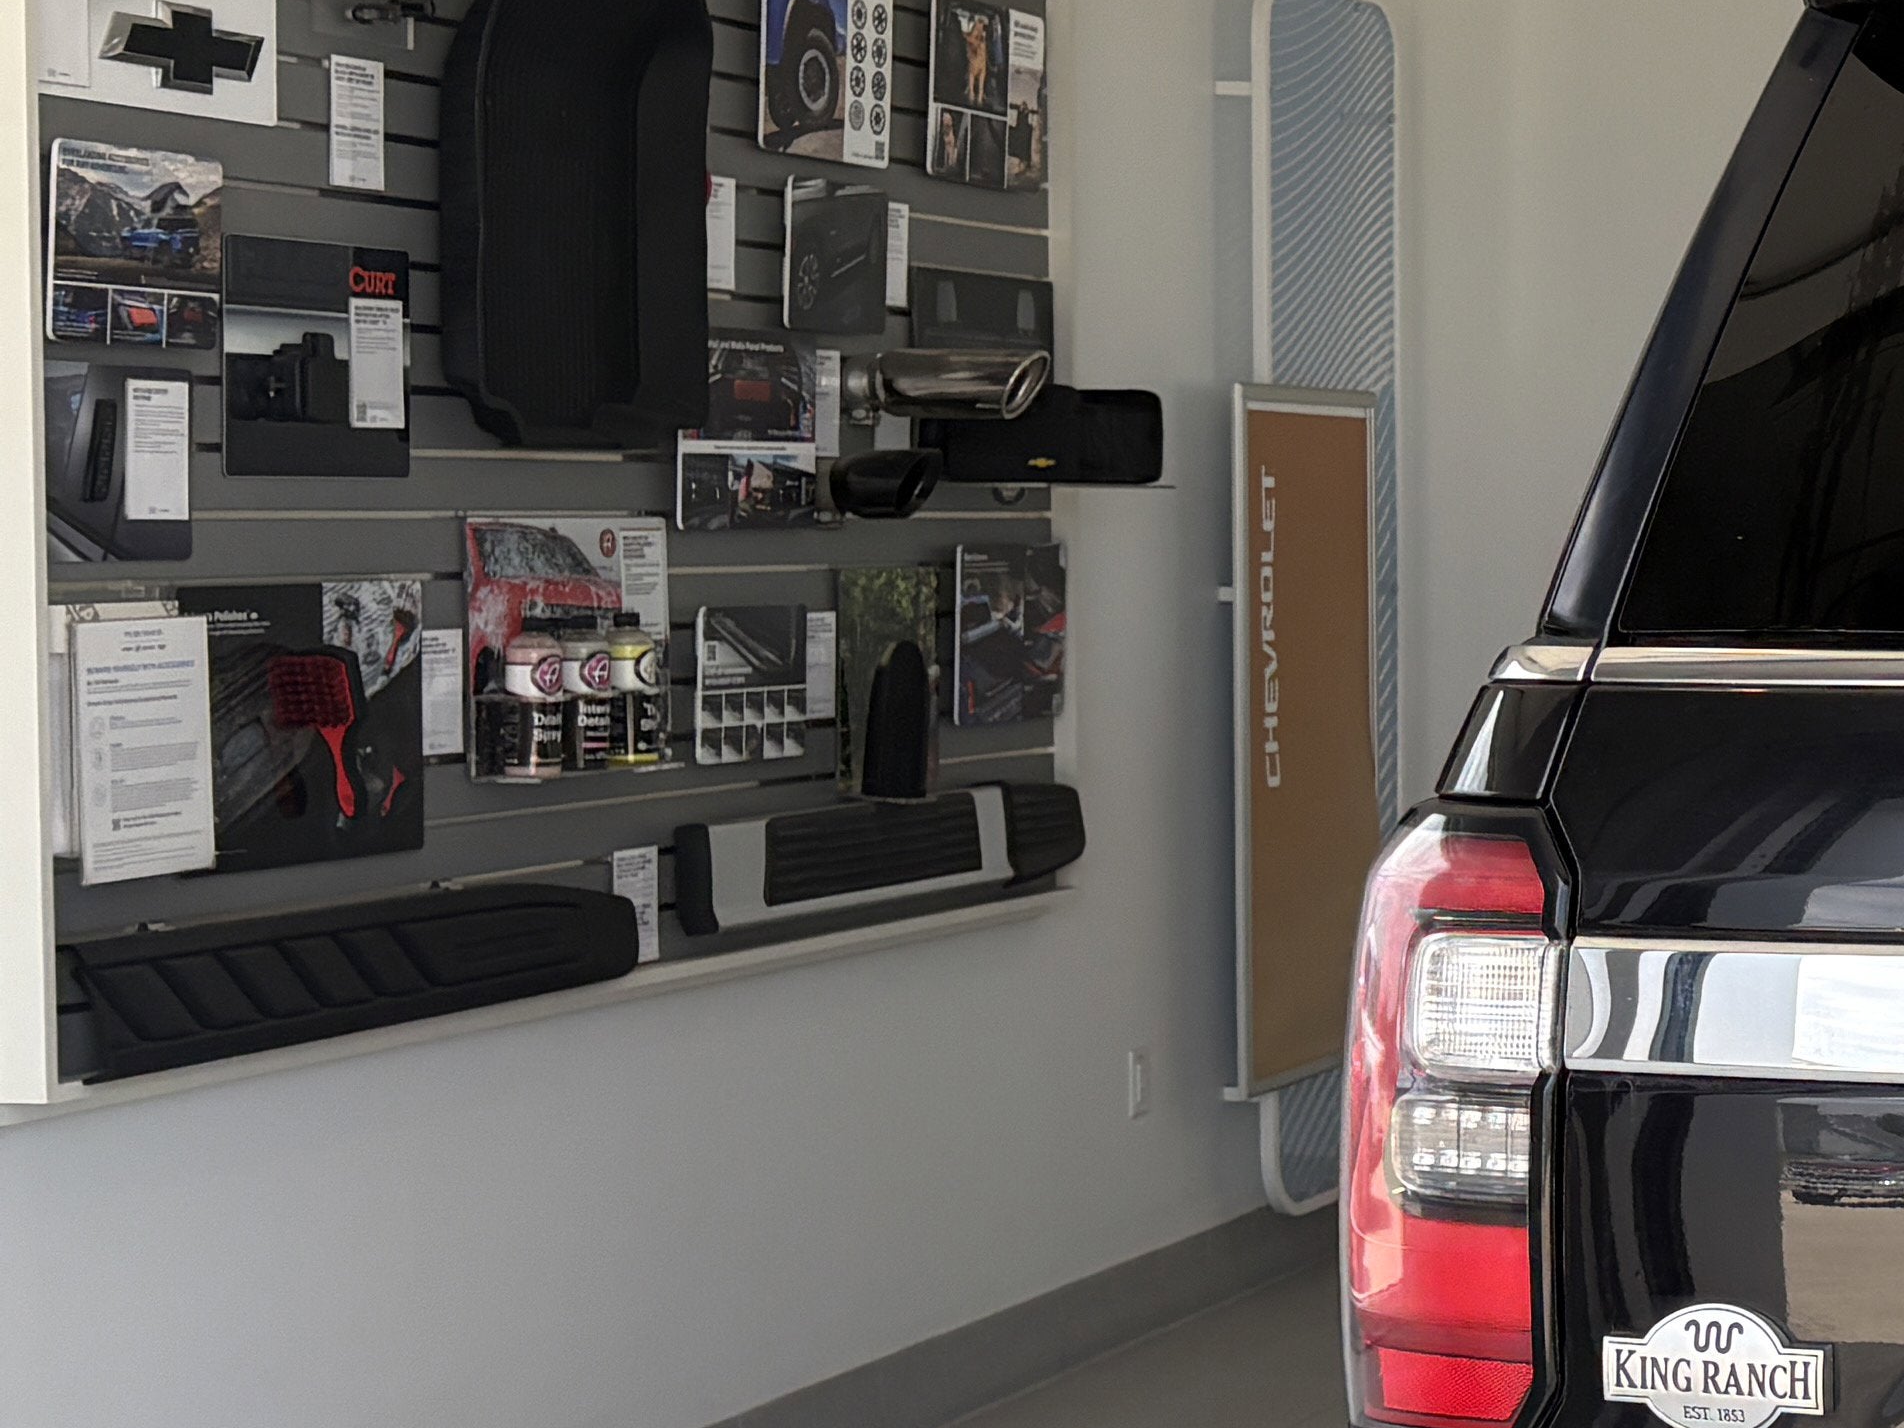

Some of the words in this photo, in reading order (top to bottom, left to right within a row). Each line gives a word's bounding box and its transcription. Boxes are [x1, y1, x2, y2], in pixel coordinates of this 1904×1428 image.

[349, 266, 396, 295] CURT
[1261, 465, 1281, 787] CHEVROLET
[1615, 1348, 1693, 1393] KING
[1702, 1360, 1812, 1401] RANCH
[1684, 1405, 1713, 1421] EST.
[1717, 1408, 1746, 1423] 1853
